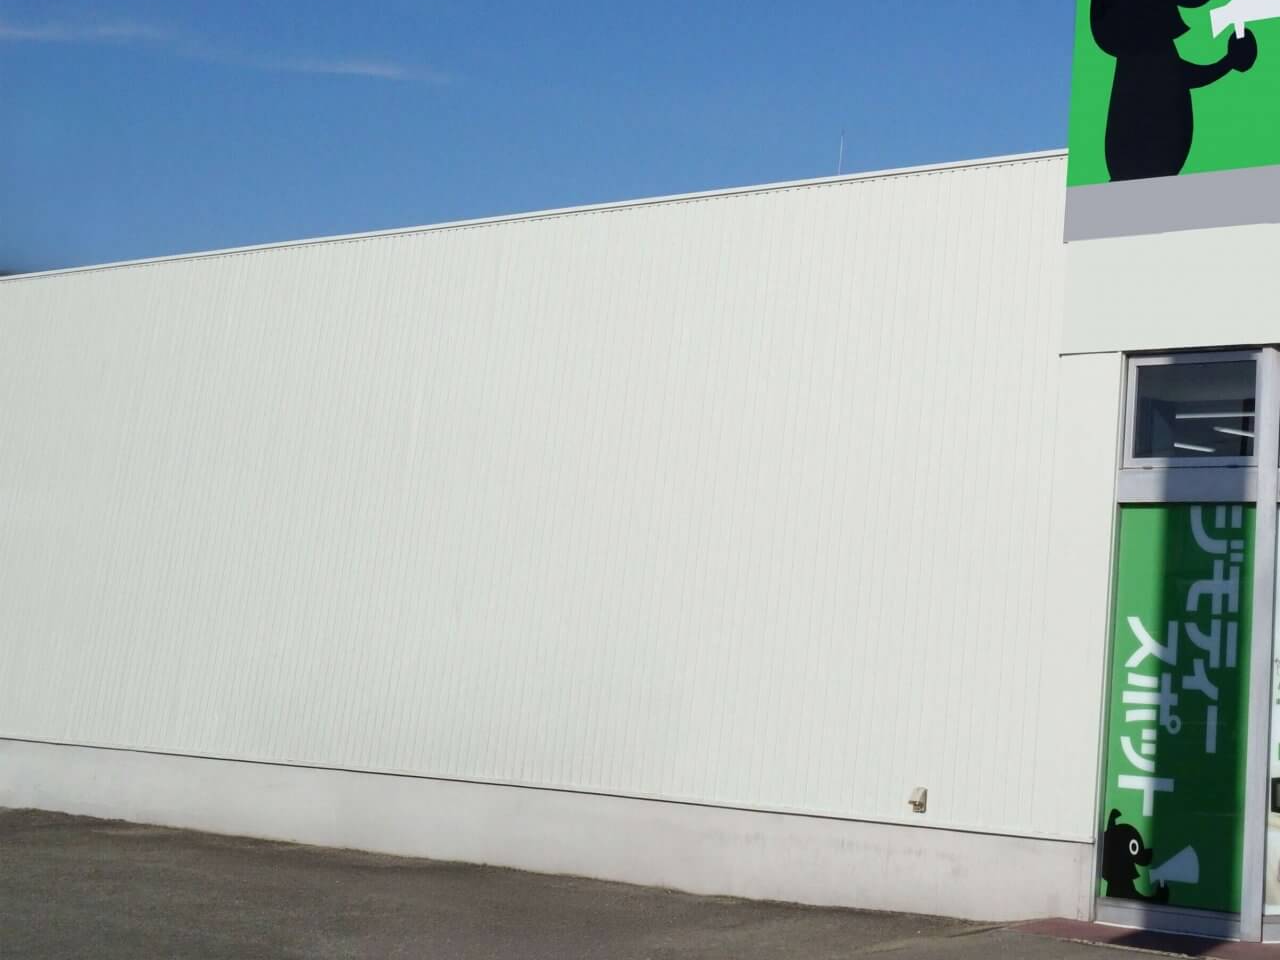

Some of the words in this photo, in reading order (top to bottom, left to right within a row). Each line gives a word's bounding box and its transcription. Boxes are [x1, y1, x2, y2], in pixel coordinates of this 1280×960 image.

[1118, 616, 1181, 816] スポット
[1182, 505, 1244, 753] ジモティー
